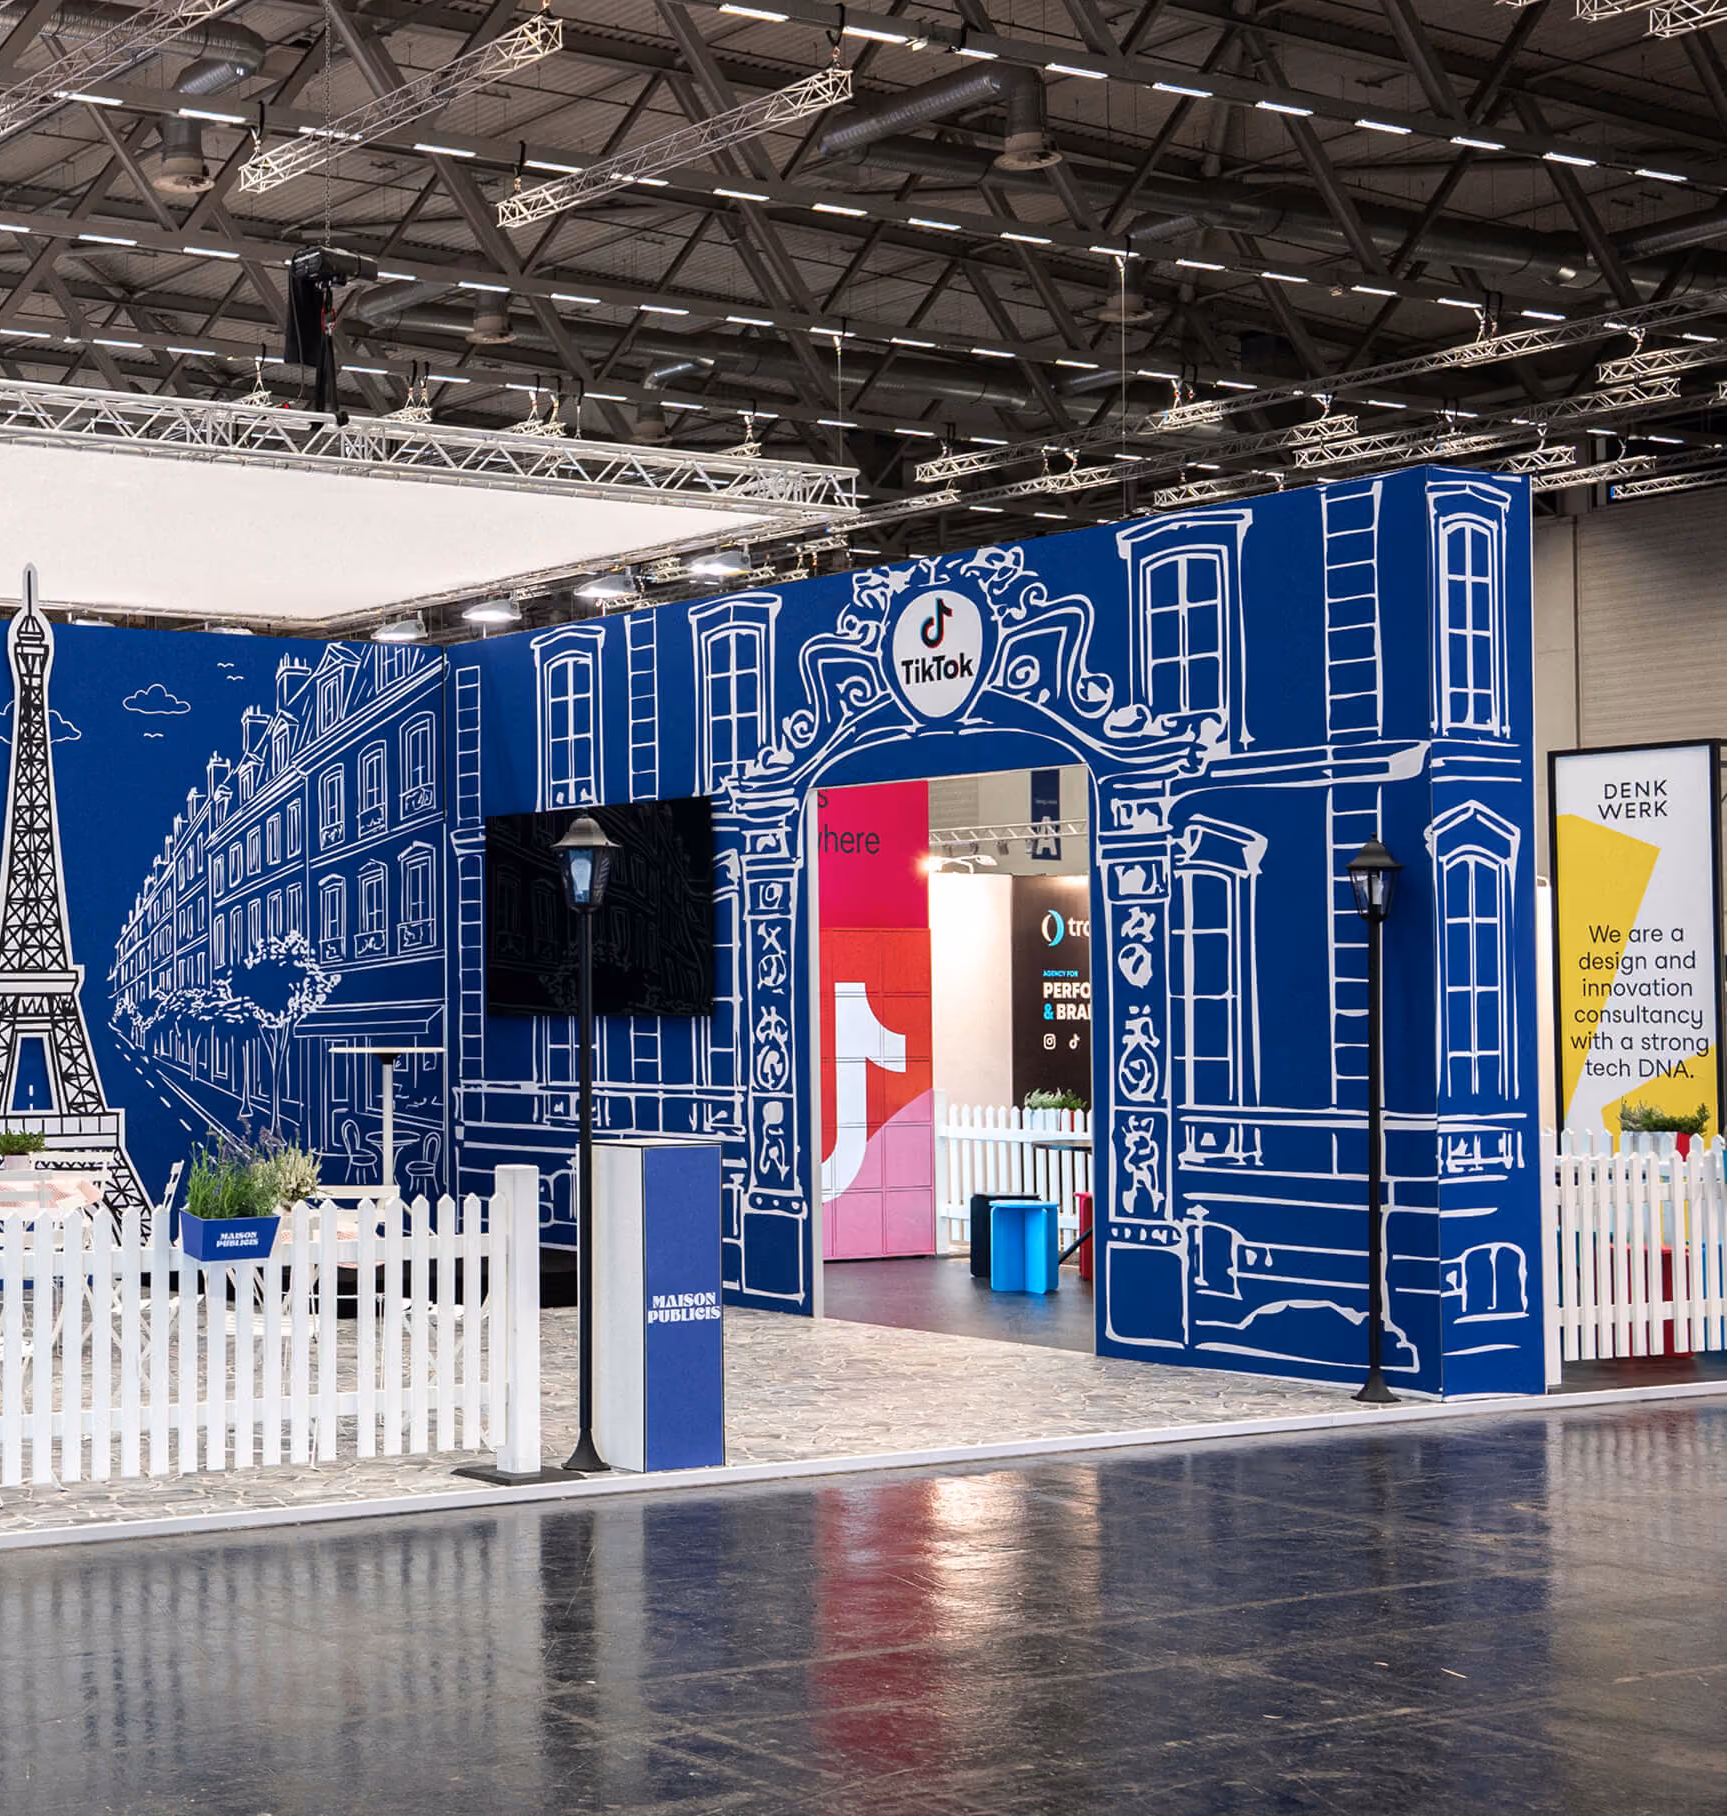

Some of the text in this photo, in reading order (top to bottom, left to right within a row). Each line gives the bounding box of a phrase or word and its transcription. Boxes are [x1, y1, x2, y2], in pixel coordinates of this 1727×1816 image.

[901, 652, 974, 685] TikTok
[1604, 779, 1668, 800] DENK
[1597, 800, 1668, 820] WERK
[817, 823, 881, 854] here
[1588, 924, 1684, 944] We are a
[1578, 950, 1696, 976] design and
[1043, 982, 1091, 999] PERFO
[1582, 977, 1693, 997] innovation
[1043, 1003, 1054, 1020] &
[1573, 1005, 1703, 1030] consultancy
[1570, 1031, 1709, 1057] with a strong
[1585, 1058, 1695, 1079] tech DNA.
[216, 1238, 259, 1248] PUBLICIS
[220, 1231, 258, 1240] MAISON
[652, 1291, 716, 1309] MAISON
[647, 1305, 722, 1324] PUBLICIS
